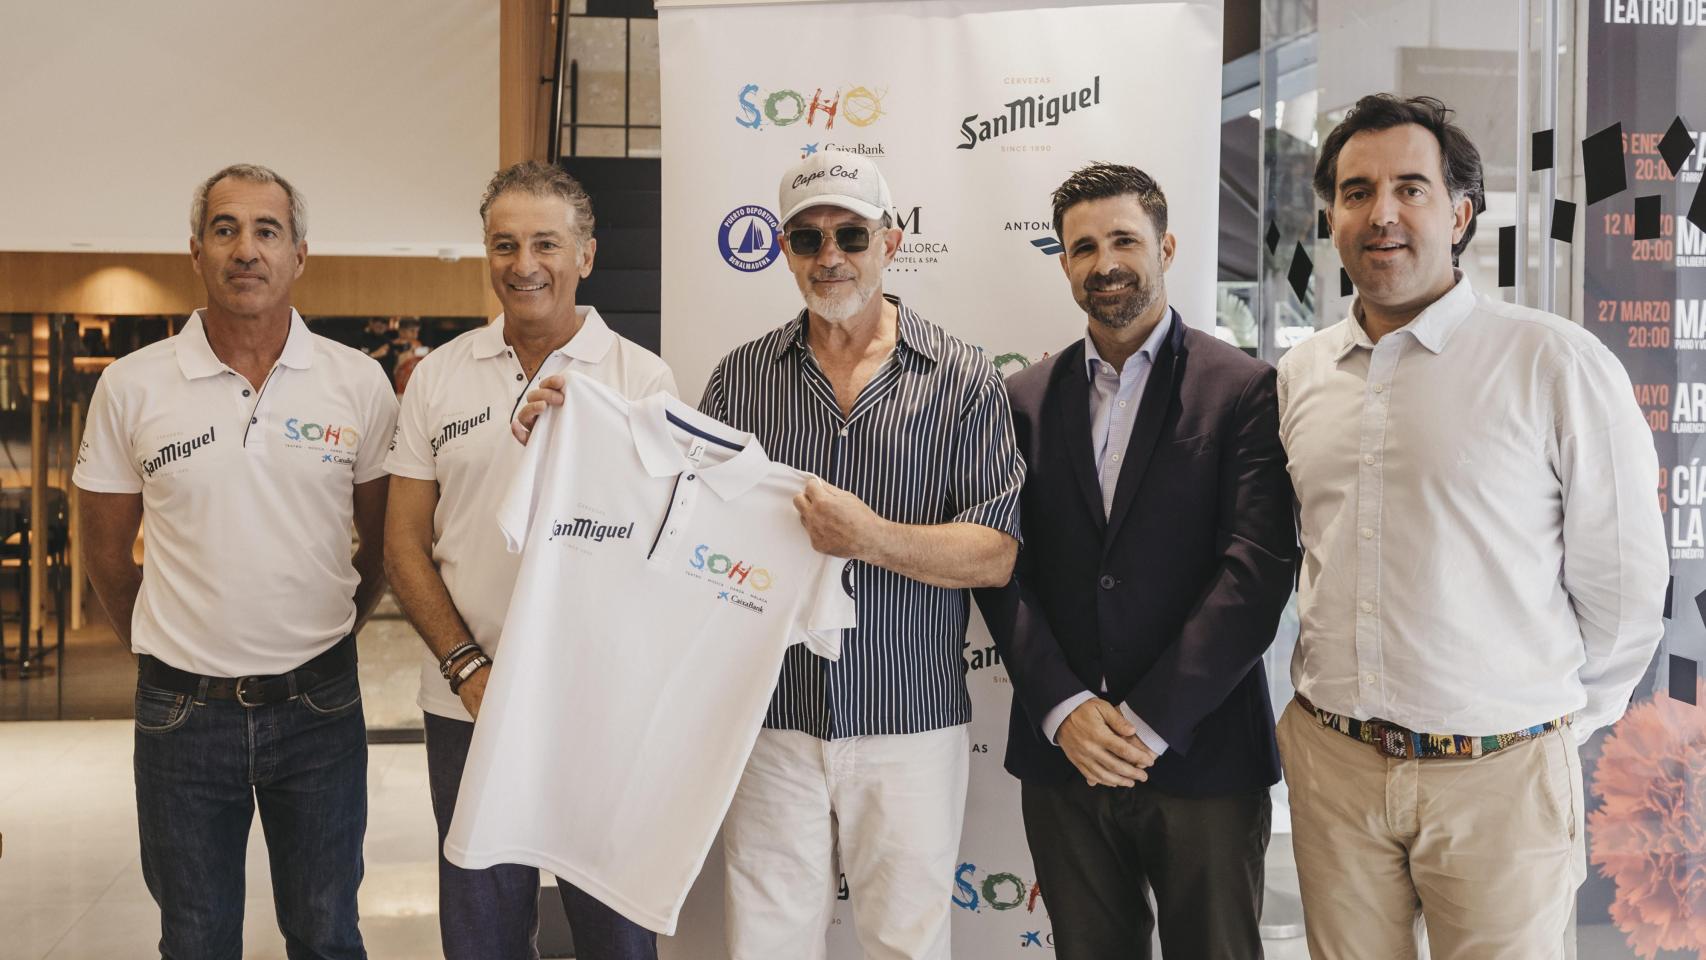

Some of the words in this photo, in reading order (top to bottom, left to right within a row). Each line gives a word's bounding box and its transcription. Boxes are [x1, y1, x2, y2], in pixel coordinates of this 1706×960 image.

[1003, 77, 1051, 85] CERVEZAS
[736, 83, 884, 131] SOHO
[1001, 145, 1026, 153] SINCE
[792, 169, 825, 189] Cape
[829, 165, 858, 180] Cod
[724, 209, 745, 228] PUERTO
[746, 207, 777, 228] DEPORTIVO
[1604, 214, 1621, 235] 12
[1631, 240, 1673, 261] 20:00
[1598, 300, 1617, 322] 27
[1620, 300, 1671, 322] MARZO
[1628, 327, 1670, 348] 20:00
[284, 417, 358, 448] SOHO
[1672, 508, 1705, 548] LA
[689, 543, 773, 592] SOHO
